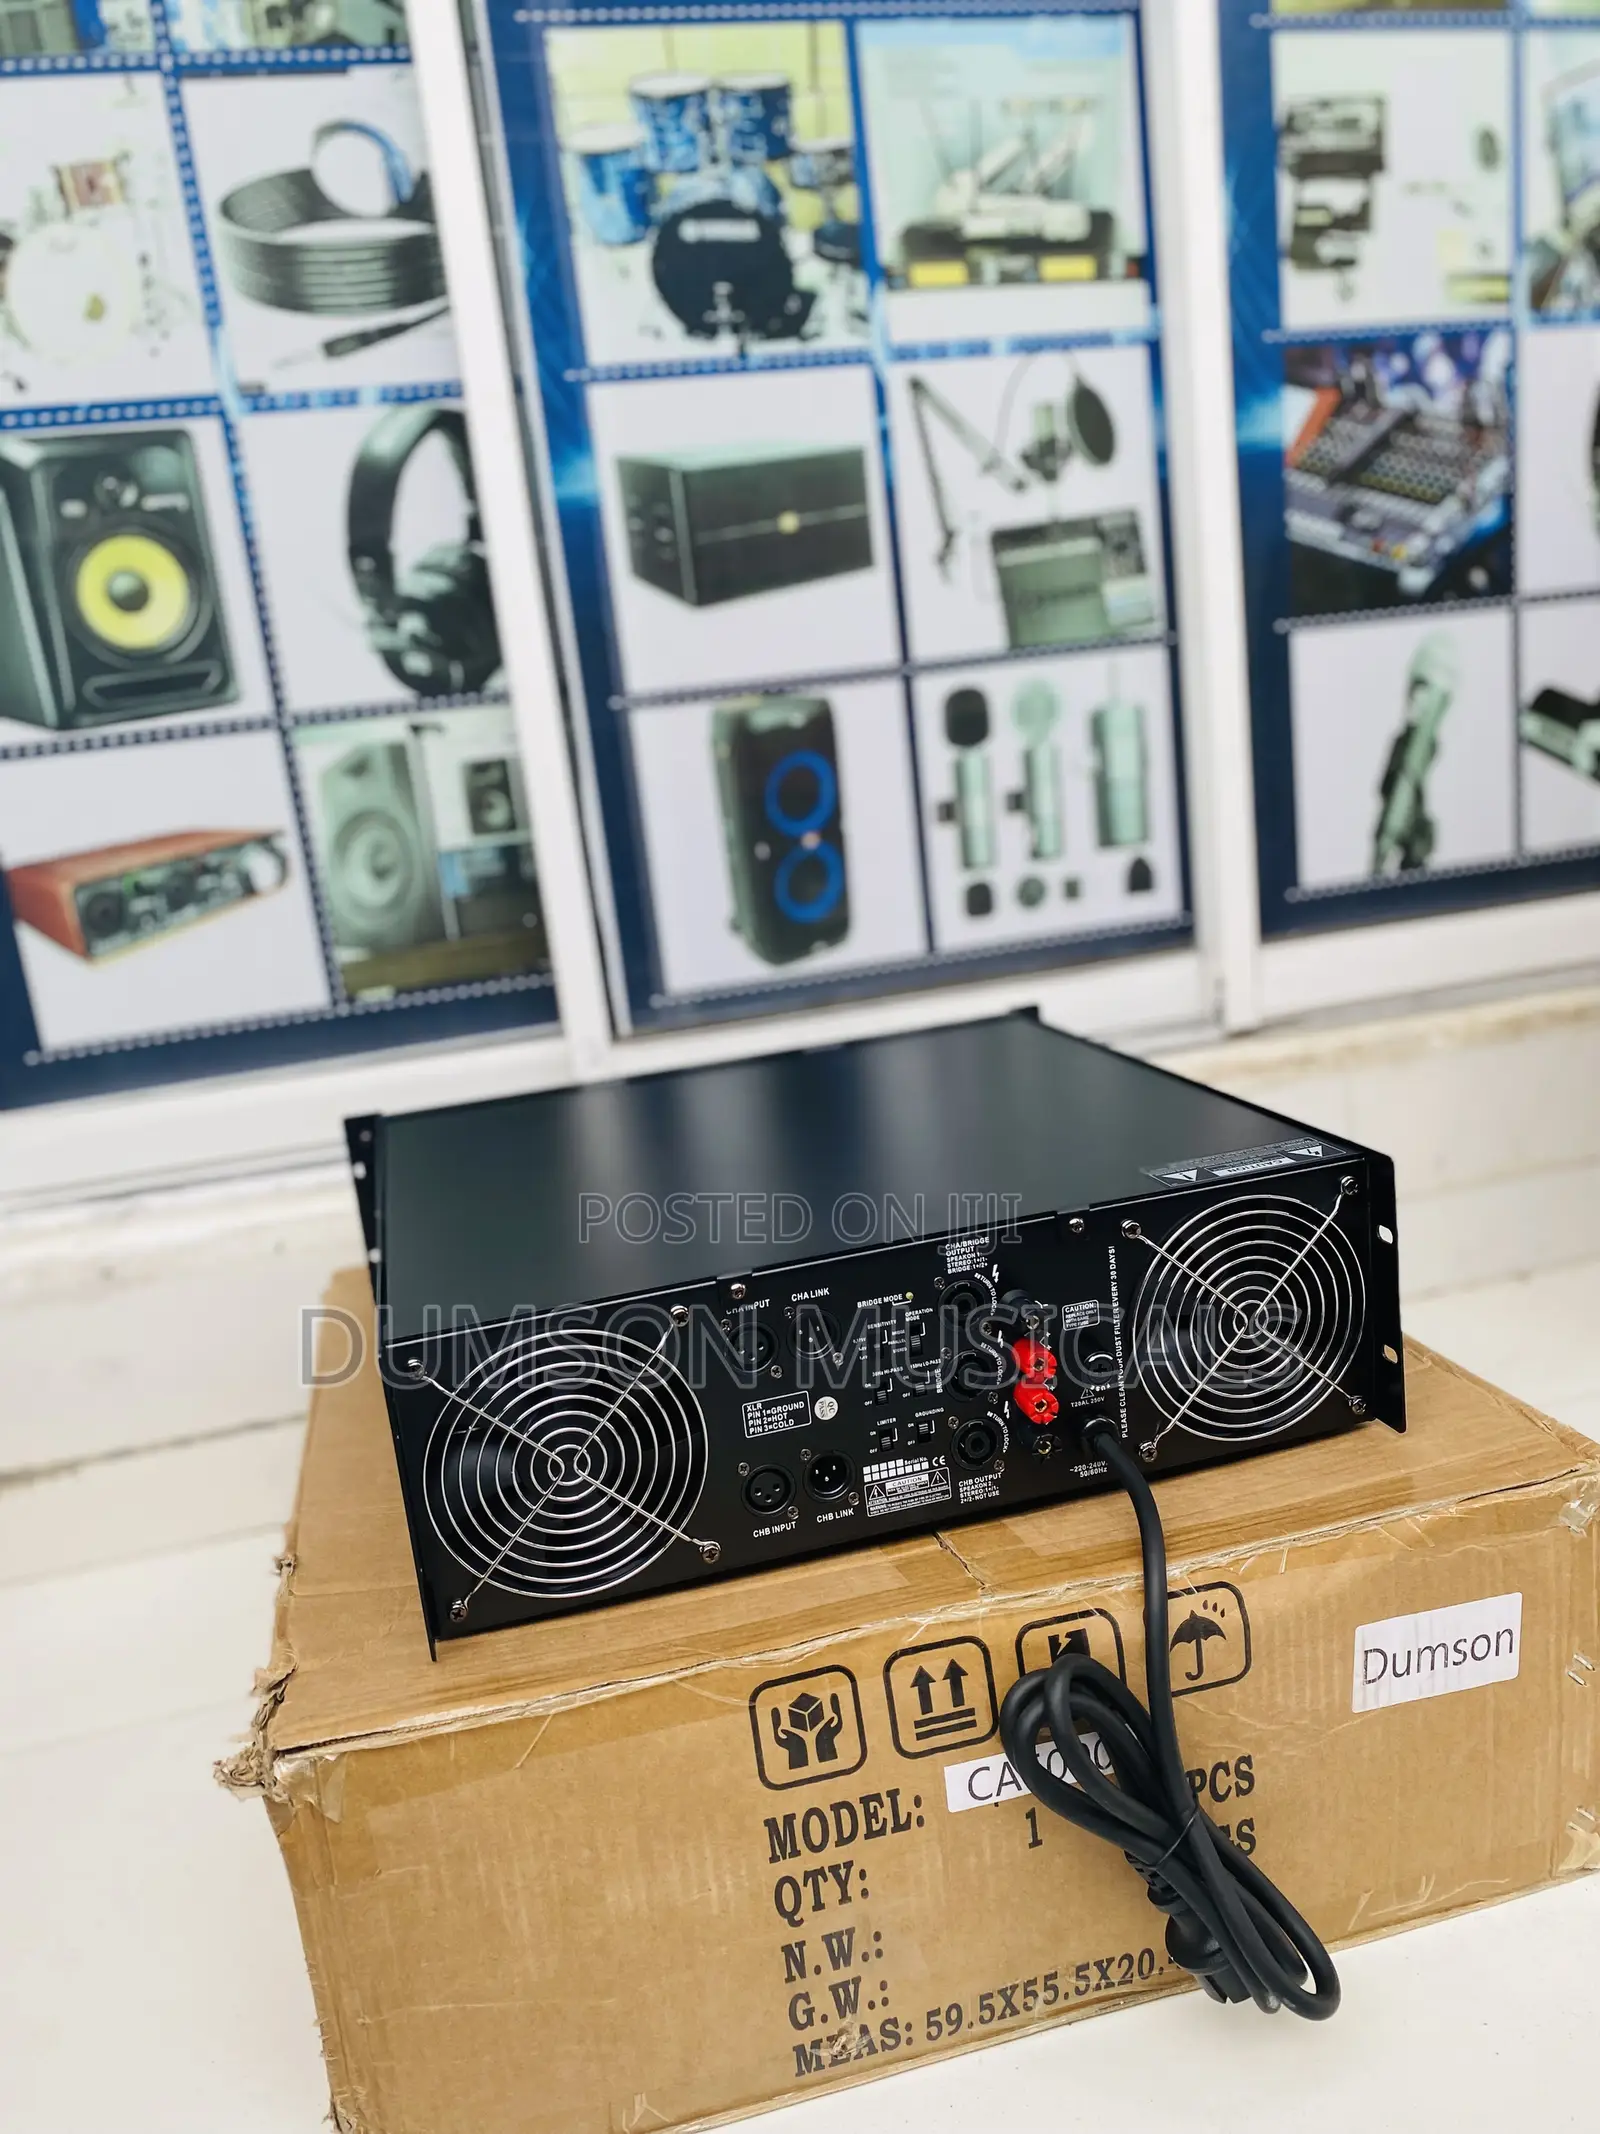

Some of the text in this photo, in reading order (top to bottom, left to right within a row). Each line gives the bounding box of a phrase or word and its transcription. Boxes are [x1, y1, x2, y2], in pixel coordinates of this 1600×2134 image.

[945, 1237, 990, 1250] CHA/BRIDGE
[945, 1246, 975, 1257] OUTPUT
[946, 1253, 976, 1262] SPEAKON
[1110, 1270, 1118, 1280] 30
[791, 1287, 830, 1302] CHA LINK
[857, 1293, 903, 1308] BRIDGE MODE
[1111, 1281, 1119, 1307] EVERY
[745, 1298, 770, 1312] INPUT
[1112, 1308, 1121, 1335] FILTER
[1114, 1336, 1123, 1357] DUST
[1116, 1357, 1125, 1380] YOUR
[1118, 1381, 1127, 1407] CLEAN
[746, 1402, 763, 1413] XLR
[827, 1401, 836, 1414] QC
[747, 1411, 761, 1420] PIN
[748, 1418, 762, 1427] PIN
[1119, 1408, 1129, 1438] PLEASE
[749, 1426, 763, 1435] PIN
[904, 1457, 920, 1466] Serial
[932, 1454, 946, 1467] CE
[892, 1476, 922, 1487] CAUTION
[958, 1472, 1003, 1487] CHB OUTPUT
[816, 1507, 855, 1523] CHB LINK
[753, 1521, 797, 1538] CHB INPUT
[1362, 1627, 1514, 1686] Dumson
[968, 1738, 1113, 1801] CA00
[763, 1788, 925, 1864] MODEL:
[774, 1754, 1255, 1928] QTY: 1 PCS
[781, 1926, 884, 1984] N.W.:
[926, 1948, 1181, 2042] 59.5X55.5X20.
[788, 1975, 889, 2031] G.W.:
